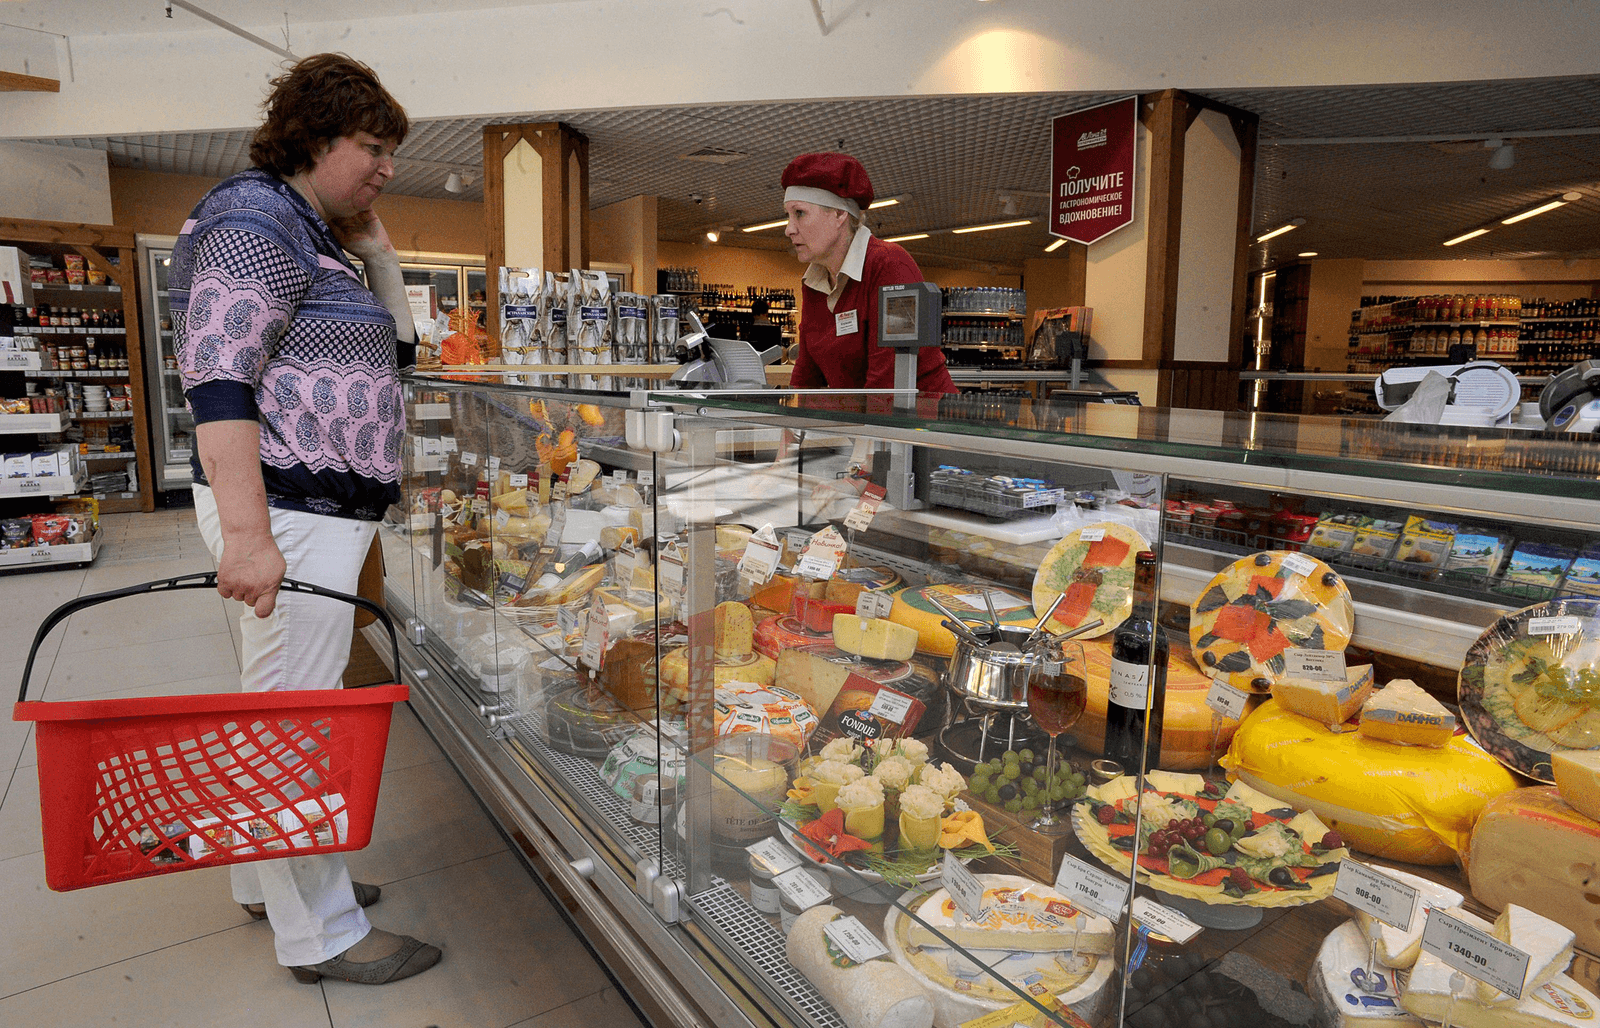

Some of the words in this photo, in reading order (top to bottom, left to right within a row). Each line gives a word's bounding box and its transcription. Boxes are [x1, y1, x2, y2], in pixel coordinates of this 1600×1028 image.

[1060, 171, 1124, 198] ПОЛУЧИТЕ
[1060, 191, 1123, 209] ГАСТРОНОМИЧЕСКОЕ
[1059, 204, 1123, 225] ВДОХНОВЕНИЕ!
[841, 715, 876, 737] FONDUE
[1343, 863, 1354, 872] Сыр
[1355, 887, 1382, 905] 908-00
[1438, 918, 1453, 929] Сыр
[1454, 925, 1488, 945] Президент
[1489, 941, 1503, 954] Бри
[1504, 949, 1520, 962] 60%
